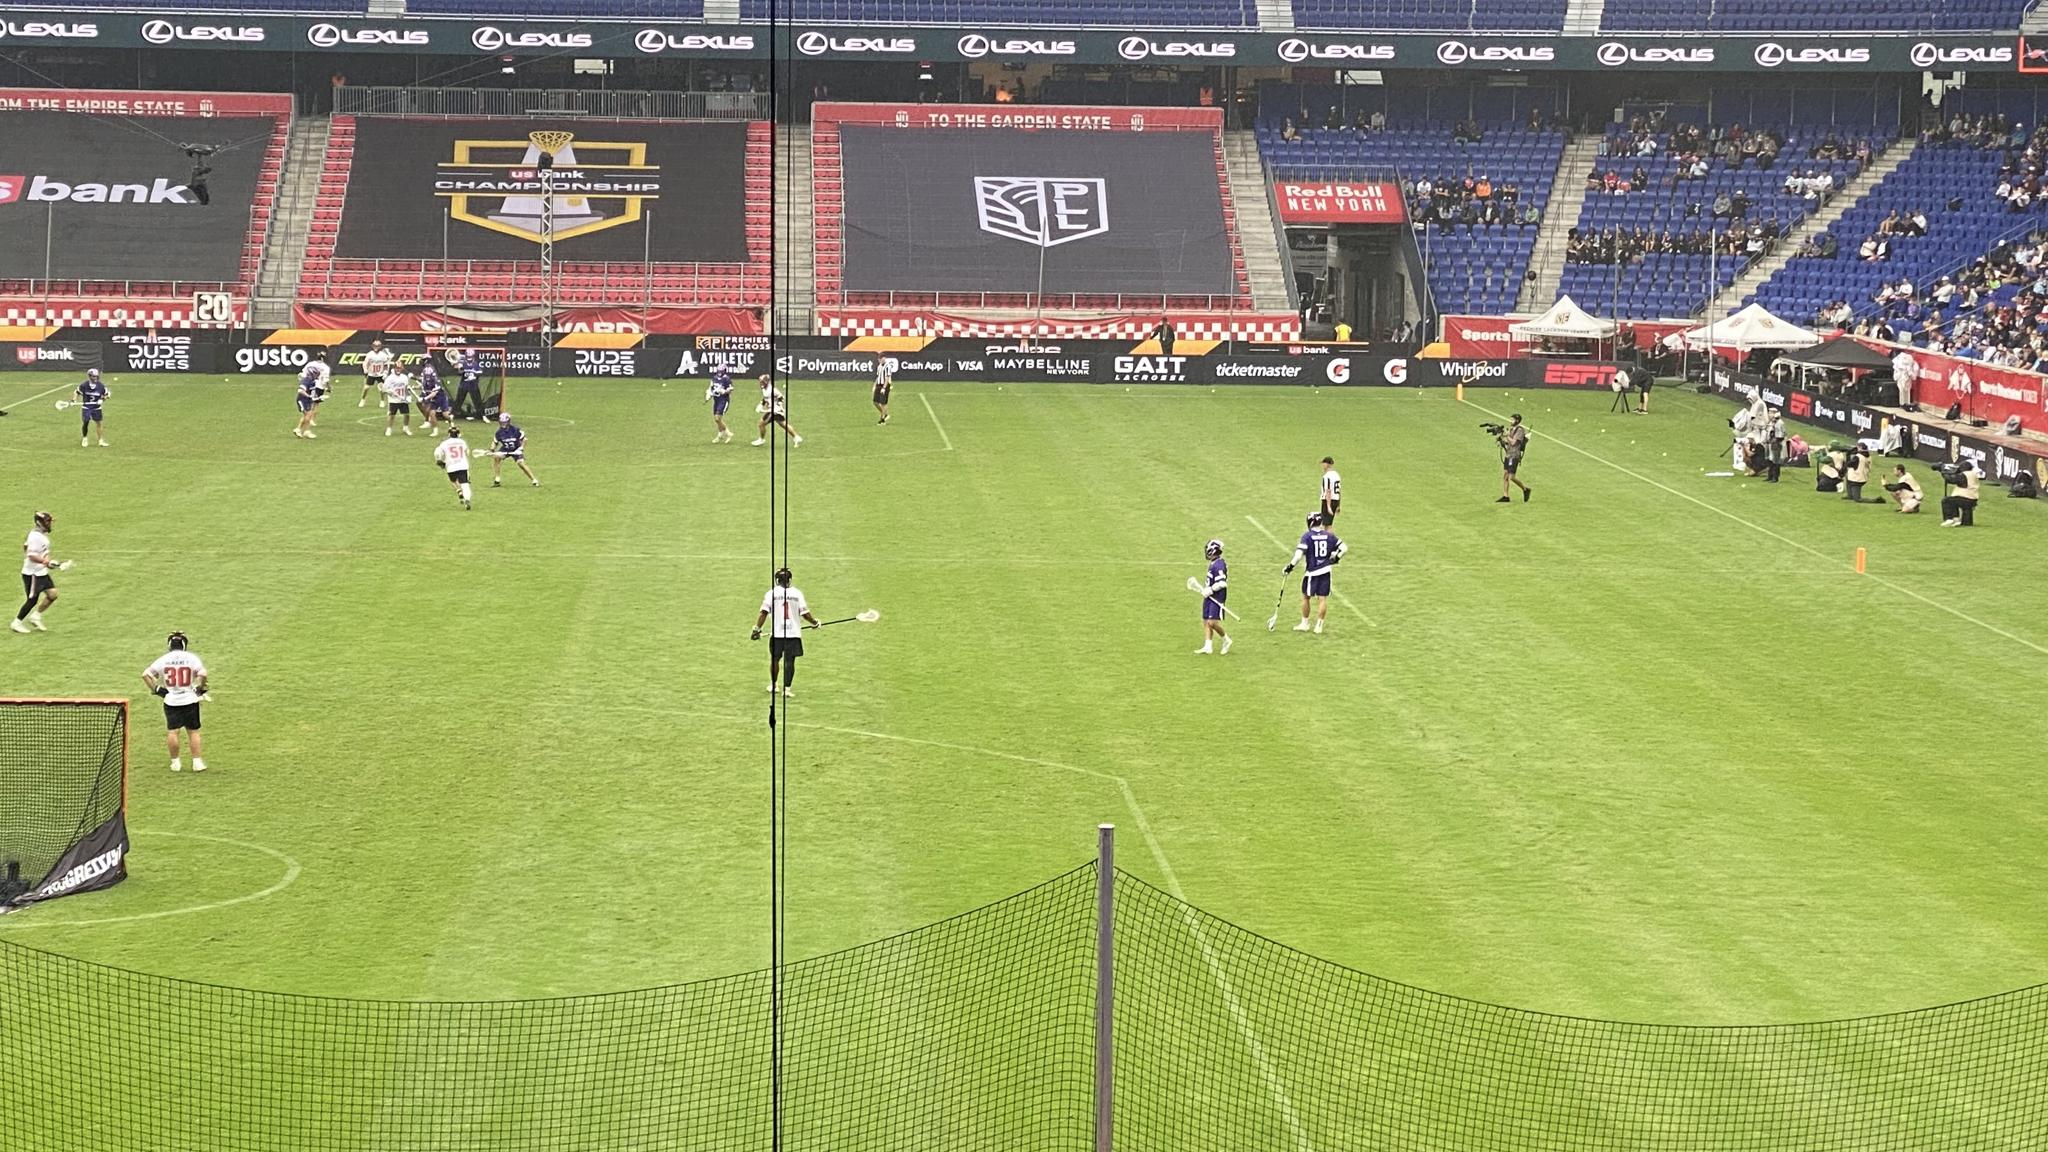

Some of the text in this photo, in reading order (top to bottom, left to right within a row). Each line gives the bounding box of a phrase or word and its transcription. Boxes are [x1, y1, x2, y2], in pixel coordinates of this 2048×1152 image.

[8, 23, 98, 37] LEXUS
[176, 26, 264, 40] LEXUS
[341, 29, 429, 44] LEXUS
[505, 33, 592, 46] LEXUS
[668, 36, 754, 49] LEXUS
[829, 38, 915, 51] LEXUS
[989, 40, 1075, 54] LEXUS
[1151, 43, 1235, 56] LEXUS
[1310, 45, 1395, 58] LEXUS
[1469, 47, 1554, 60] LEXUS
[1630, 48, 1714, 61] LEXUS
[1787, 49, 1869, 62] LEXUS
[1938, 48, 2012, 61] LEXUS
[133, 101, 185, 116] STATE
[928, 113, 1112, 130] TO THE GARDEN STATE
[27, 175, 198, 204] bank
[1285, 185, 1383, 198] Red Bull
[1287, 198, 1387, 212] NEW YORK
[724, 336, 769, 344] PREMIER
[1461, 328, 1511, 342] Sports
[18, 348, 74, 360] us bank
[129, 345, 189, 360] DUDE
[1303, 346, 1329, 355] bank
[128, 358, 191, 370] WIPES
[235, 345, 310, 373] gusto
[576, 351, 634, 366] DUDE
[700, 352, 755, 365] ATHLETIC
[798, 357, 874, 374] Polymarket
[956, 361, 983, 370] VISA
[994, 358, 1091, 370] MAYBELLINE
[1114, 356, 1187, 374] GAIT
[575, 364, 635, 375] WIPES
[900, 360, 944, 374] Cash App
[1215, 362, 1302, 377] ticketmaster
[1440, 361, 1508, 378] Whirlpool
[1114, 374, 1187, 382] LACROSSE
[448, 446, 465, 460] 51
[1313, 540, 1328, 558] 18
[782, 601, 790, 620] 1
[164, 666, 192, 687] 30
